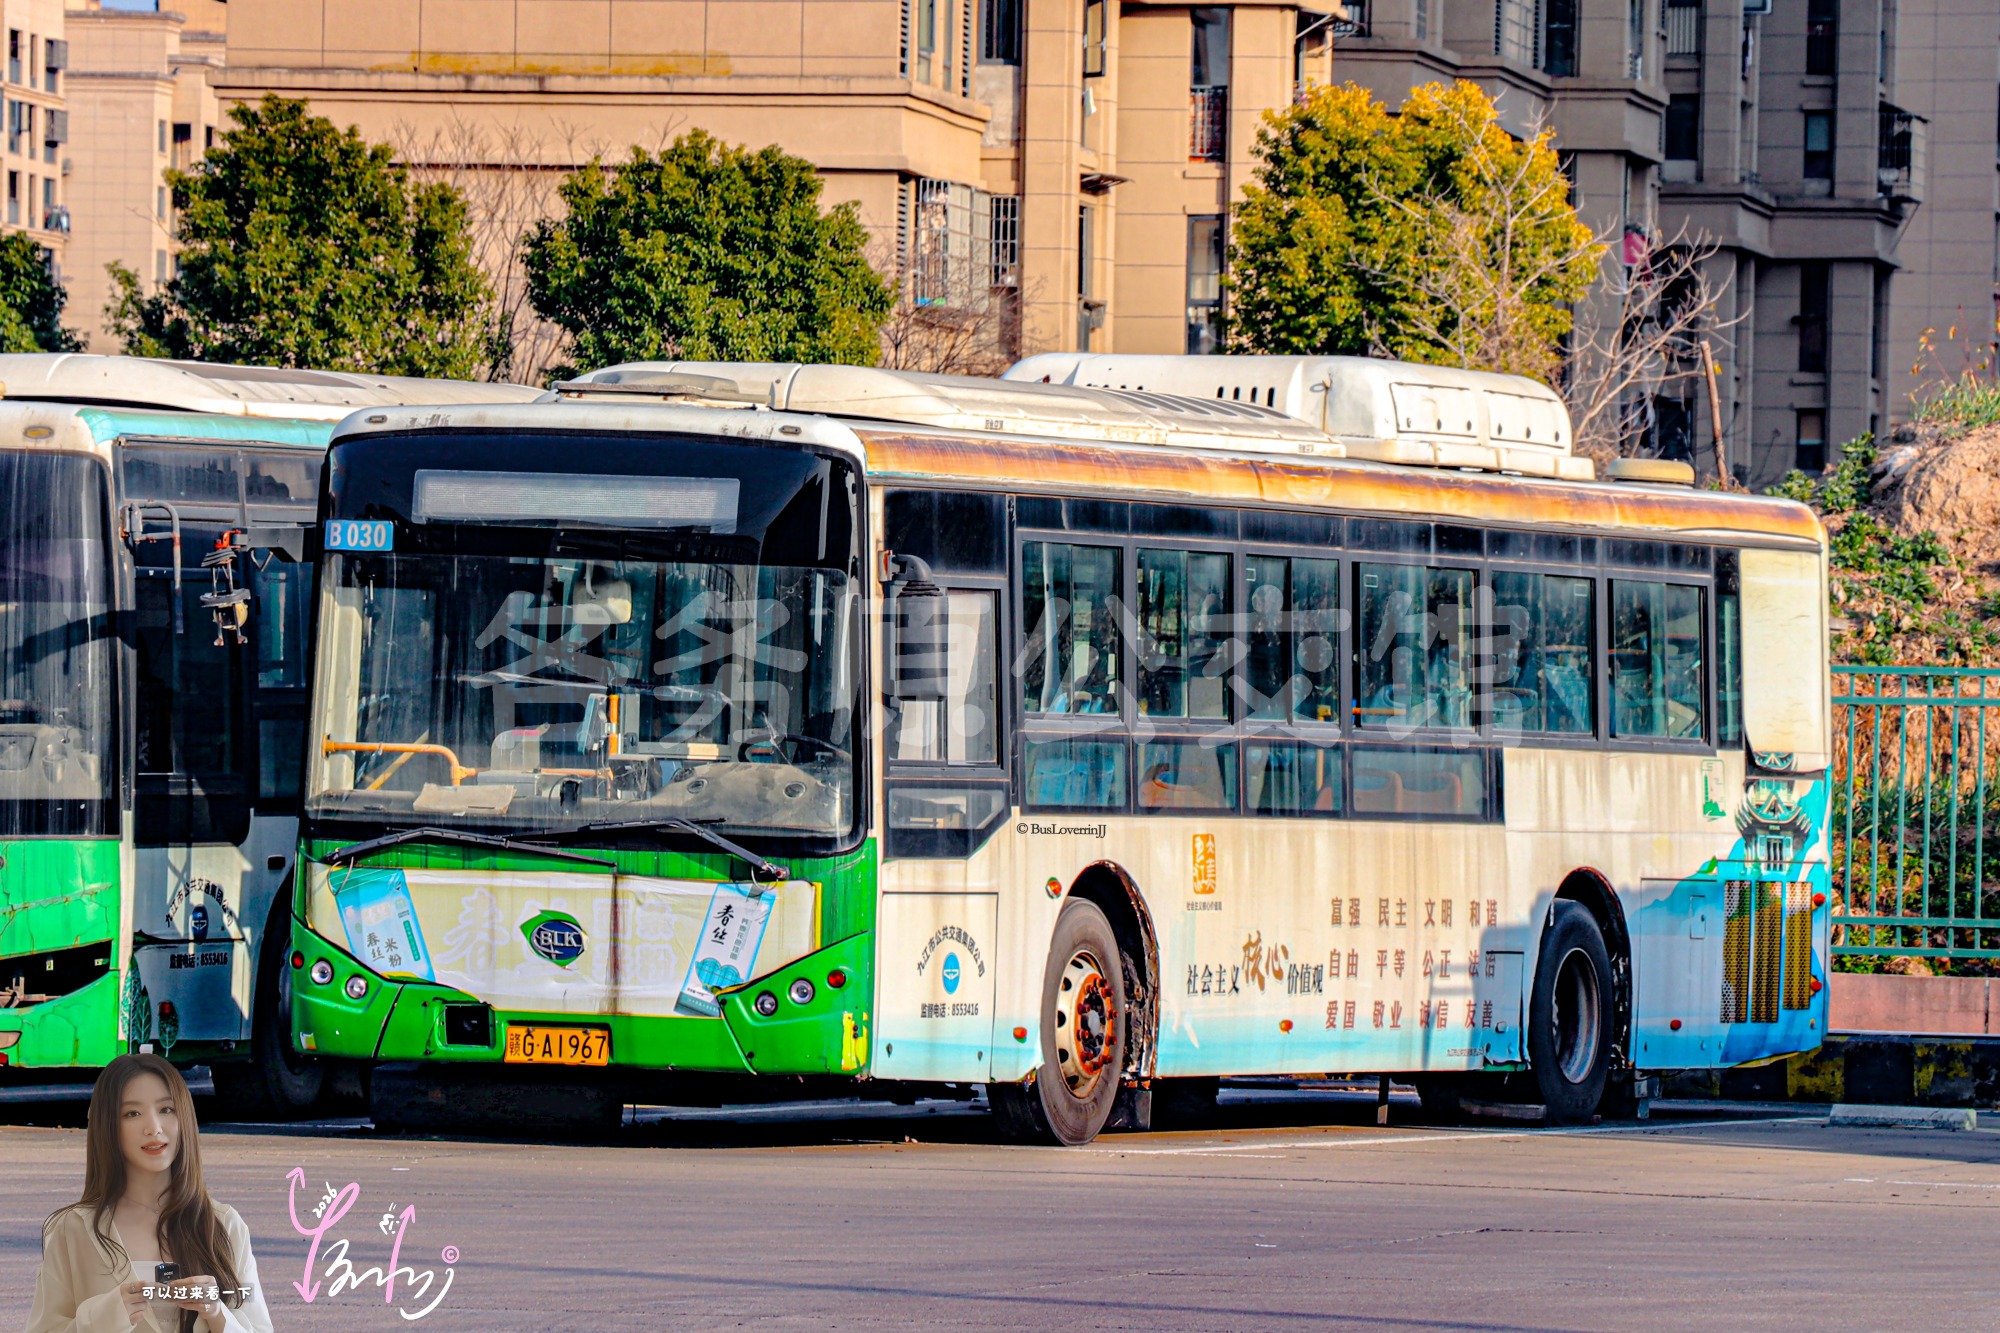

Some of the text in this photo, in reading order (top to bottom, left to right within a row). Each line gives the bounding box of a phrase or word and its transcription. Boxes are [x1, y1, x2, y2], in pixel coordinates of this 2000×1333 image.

[329, 523, 387, 548] B 030
[1331, 897, 1498, 927] 富强 民主 文明 和谐
[540, 930, 578, 947] BLK
[917, 924, 986, 978] 九江市公共交通集团公司
[1329, 948, 1496, 978] 自由 平等 公正 法治
[1325, 1000, 1493, 1029] 爱国 敬业 诚信 友善
